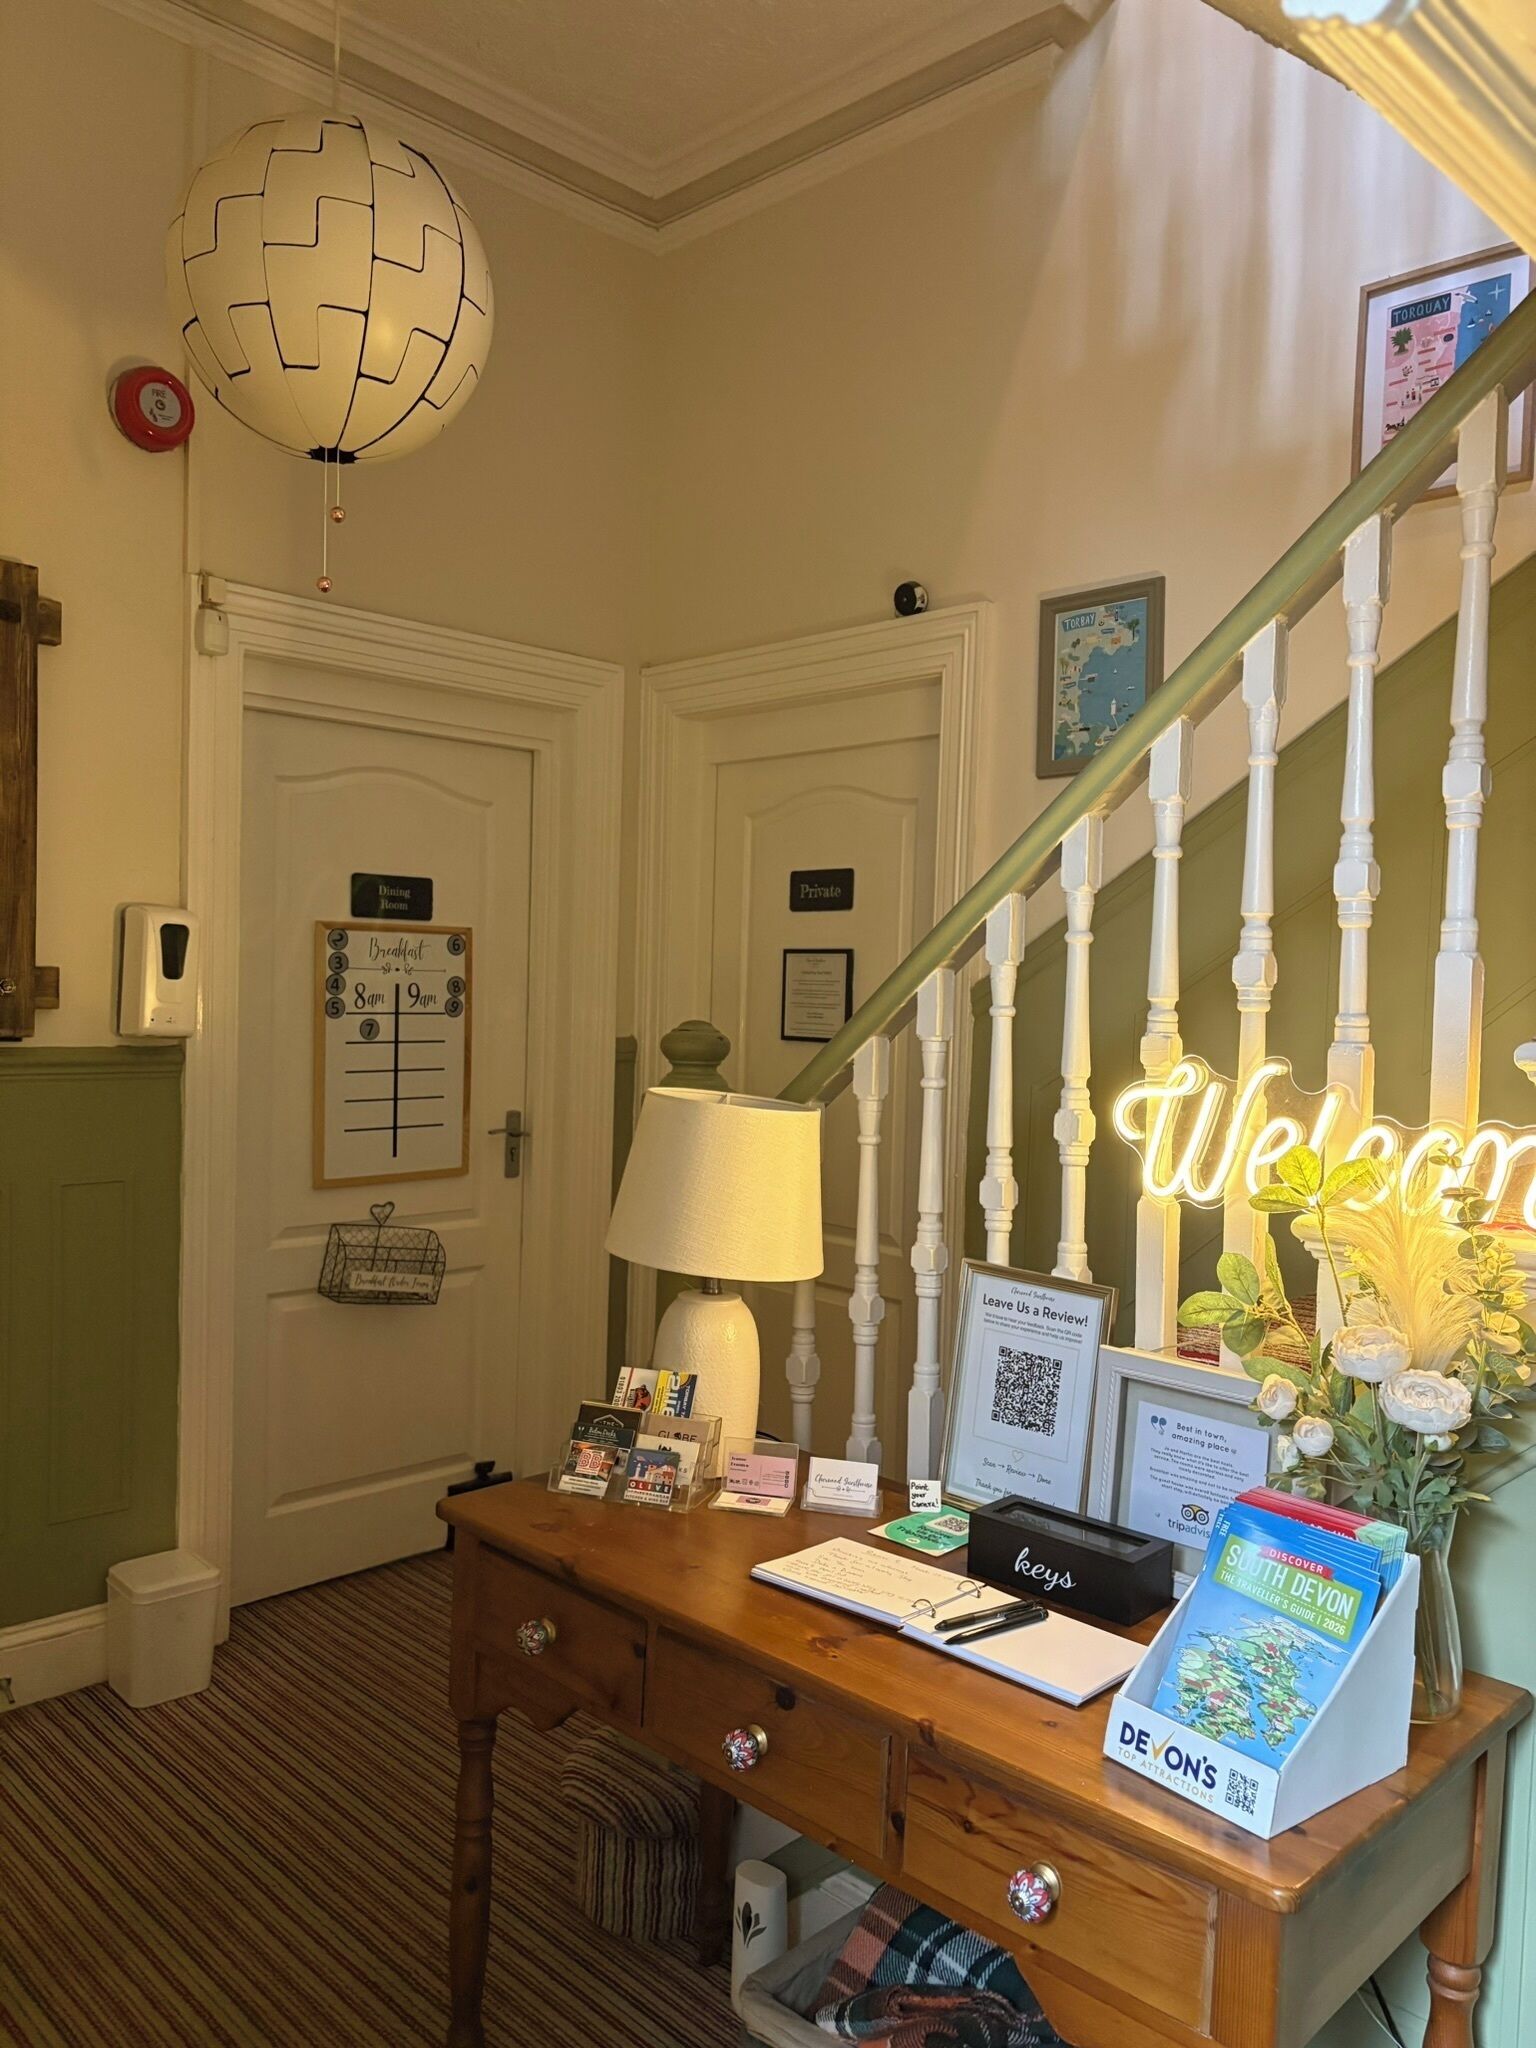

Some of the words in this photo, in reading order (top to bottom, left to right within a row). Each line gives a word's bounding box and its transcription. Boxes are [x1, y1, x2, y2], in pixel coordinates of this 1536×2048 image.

[1393, 297, 1450, 323] TORQUAY
[151, 389, 167, 398] FIRE
[1064, 614, 1095, 630] TORBAY
[378, 885, 411, 898] Dining
[800, 884, 842, 899] Private
[380, 899, 408, 910] Room
[369, 937, 431, 961] Breakfast
[452, 938, 460, 951] 6
[334, 955, 343, 970] 3
[330, 978, 340, 992] 4
[453, 981, 460, 994] 8
[354, 983, 385, 1009] 8am
[408, 983, 438, 1008] 9am
[331, 999, 340, 1015] 5
[450, 1001, 459, 1013] 9
[366, 1023, 374, 1036] 7
[983, 1294, 1013, 1311] Leave
[1017, 1301, 1030, 1315] Us
[1033, 1307, 1039, 1317] a
[1043, 1307, 1088, 1327] Review!
[683, 1385, 691, 1410] TORBAY
[1176, 1422, 1192, 1433] Best
[1195, 1427, 1201, 1435] in
[1204, 1429, 1226, 1442] town,
[1171, 1433, 1205, 1447] amazing
[1207, 1442, 1229, 1452] place
[982, 1457, 996, 1468] Scan
[1005, 1463, 1026, 1476] Review
[1036, 1473, 1051, 1484] Done
[1179, 1474, 1197, 1483] amazing
[629, 1480, 669, 1493] OLIVE
[911, 1482, 929, 1491] Point
[975, 1478, 991, 1489] Thank
[1219, 1520, 1231, 1537] FREE
[1014, 1547, 1076, 1590] keys
[1268, 1549, 1324, 1574] DISCOVER
[1225, 1544, 1288, 1592] SOUTH
[1292, 1571, 1354, 1620] DEVON
[1220, 1571, 1235, 1586] THE
[1237, 1578, 1289, 1609] TRAVELLER'S
[1290, 1603, 1315, 1622] GUIDE
[1323, 1618, 1346, 1635] 2026
[1120, 1721, 1218, 1790] DEVON'S
[1117, 1746, 1137, 1760] TOP
[1140, 1760, 1215, 1804] ATTRACTIONS
